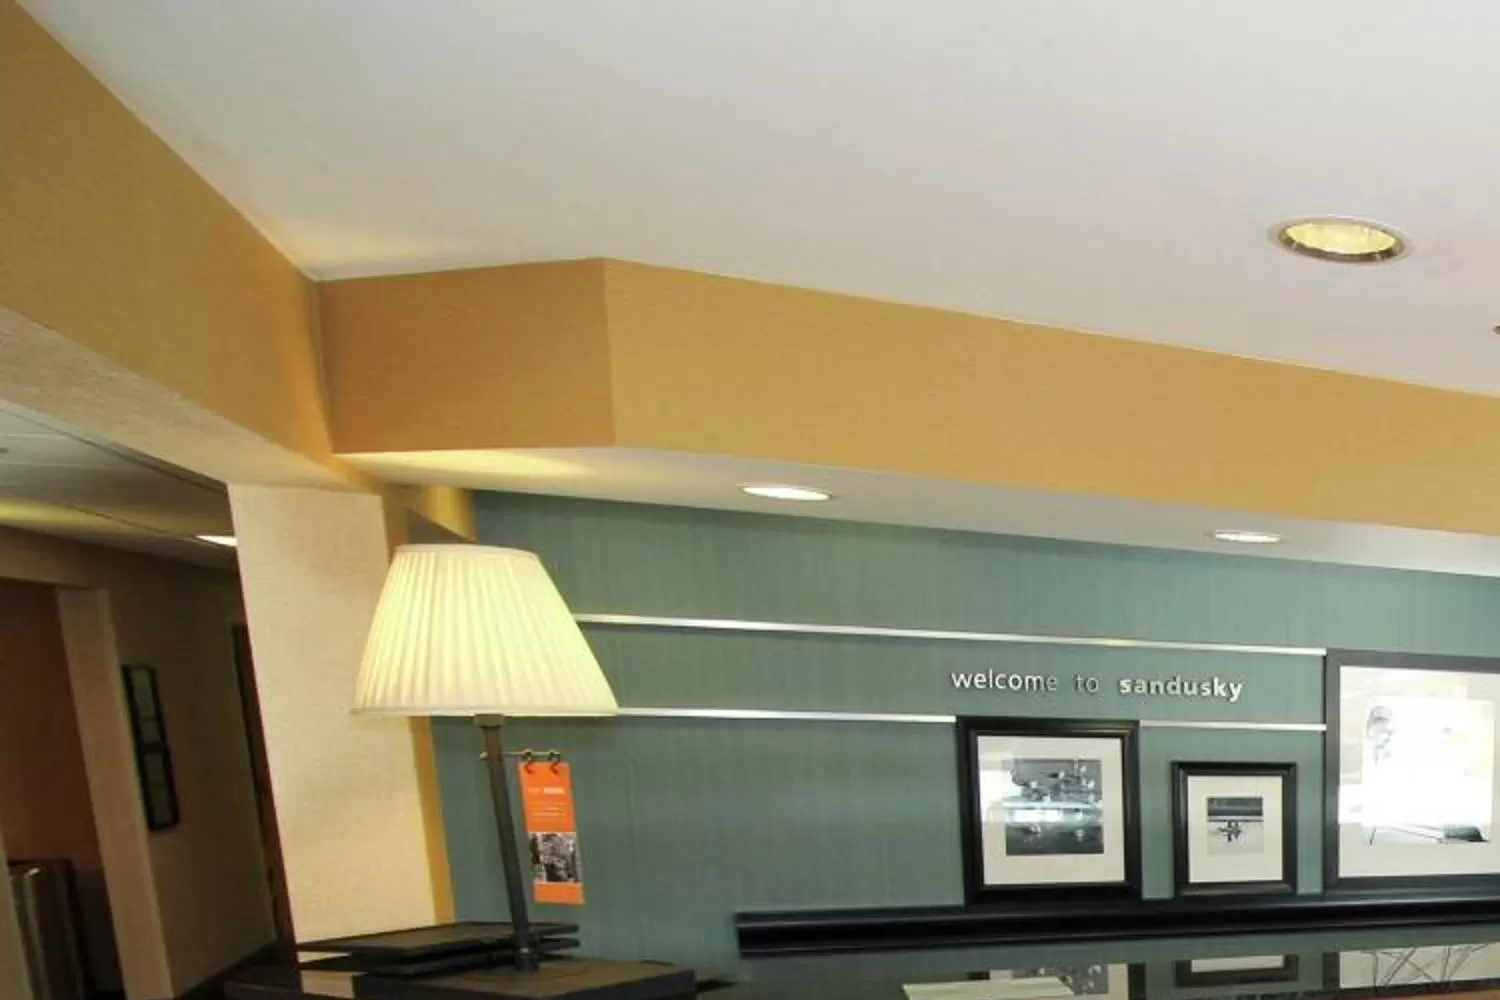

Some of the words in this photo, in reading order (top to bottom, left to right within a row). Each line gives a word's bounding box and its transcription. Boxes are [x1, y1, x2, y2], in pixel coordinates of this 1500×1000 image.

[951, 668, 1058, 691] welcome
[1075, 673, 1099, 693] to
[1119, 676, 1242, 702] sandusky
